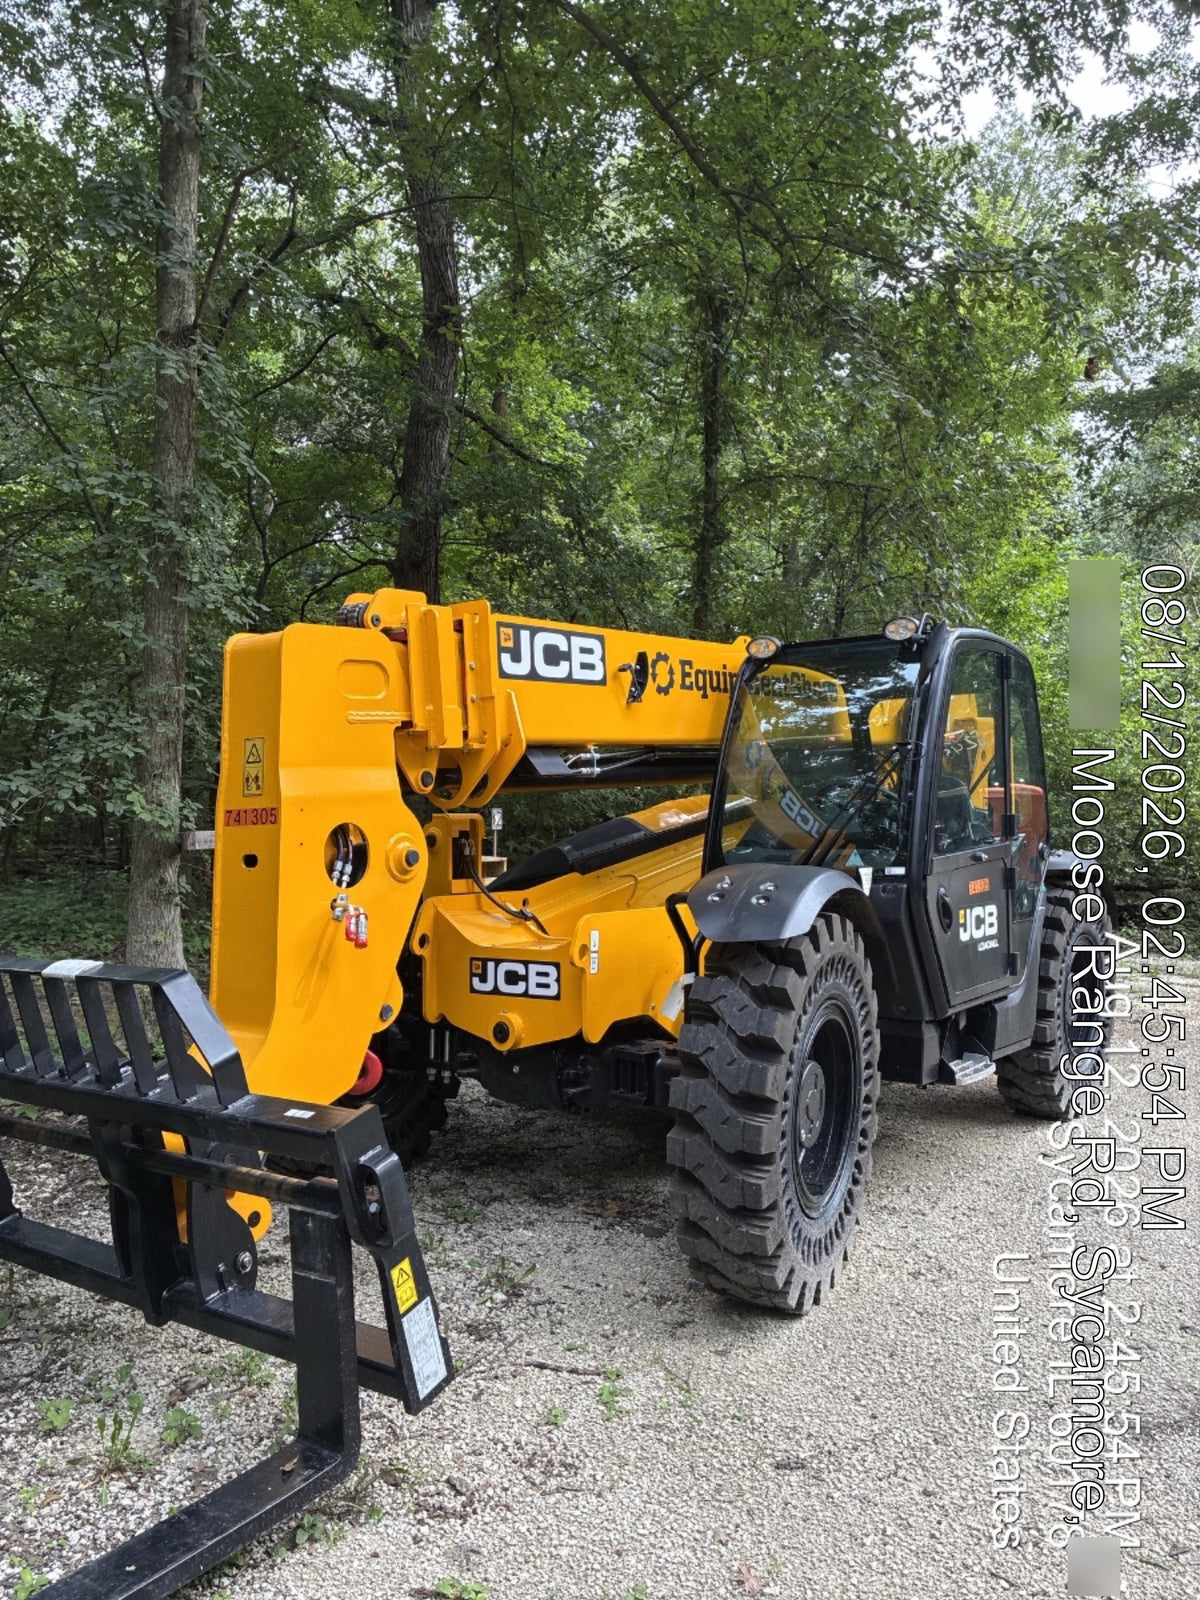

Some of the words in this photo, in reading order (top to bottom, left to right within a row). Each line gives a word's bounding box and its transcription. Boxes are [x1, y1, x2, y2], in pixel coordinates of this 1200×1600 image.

[501, 629, 604, 680] JCB
[225, 807, 278, 826] 741305
[959, 904, 998, 942] JCB
[472, 961, 558, 997] JCB
